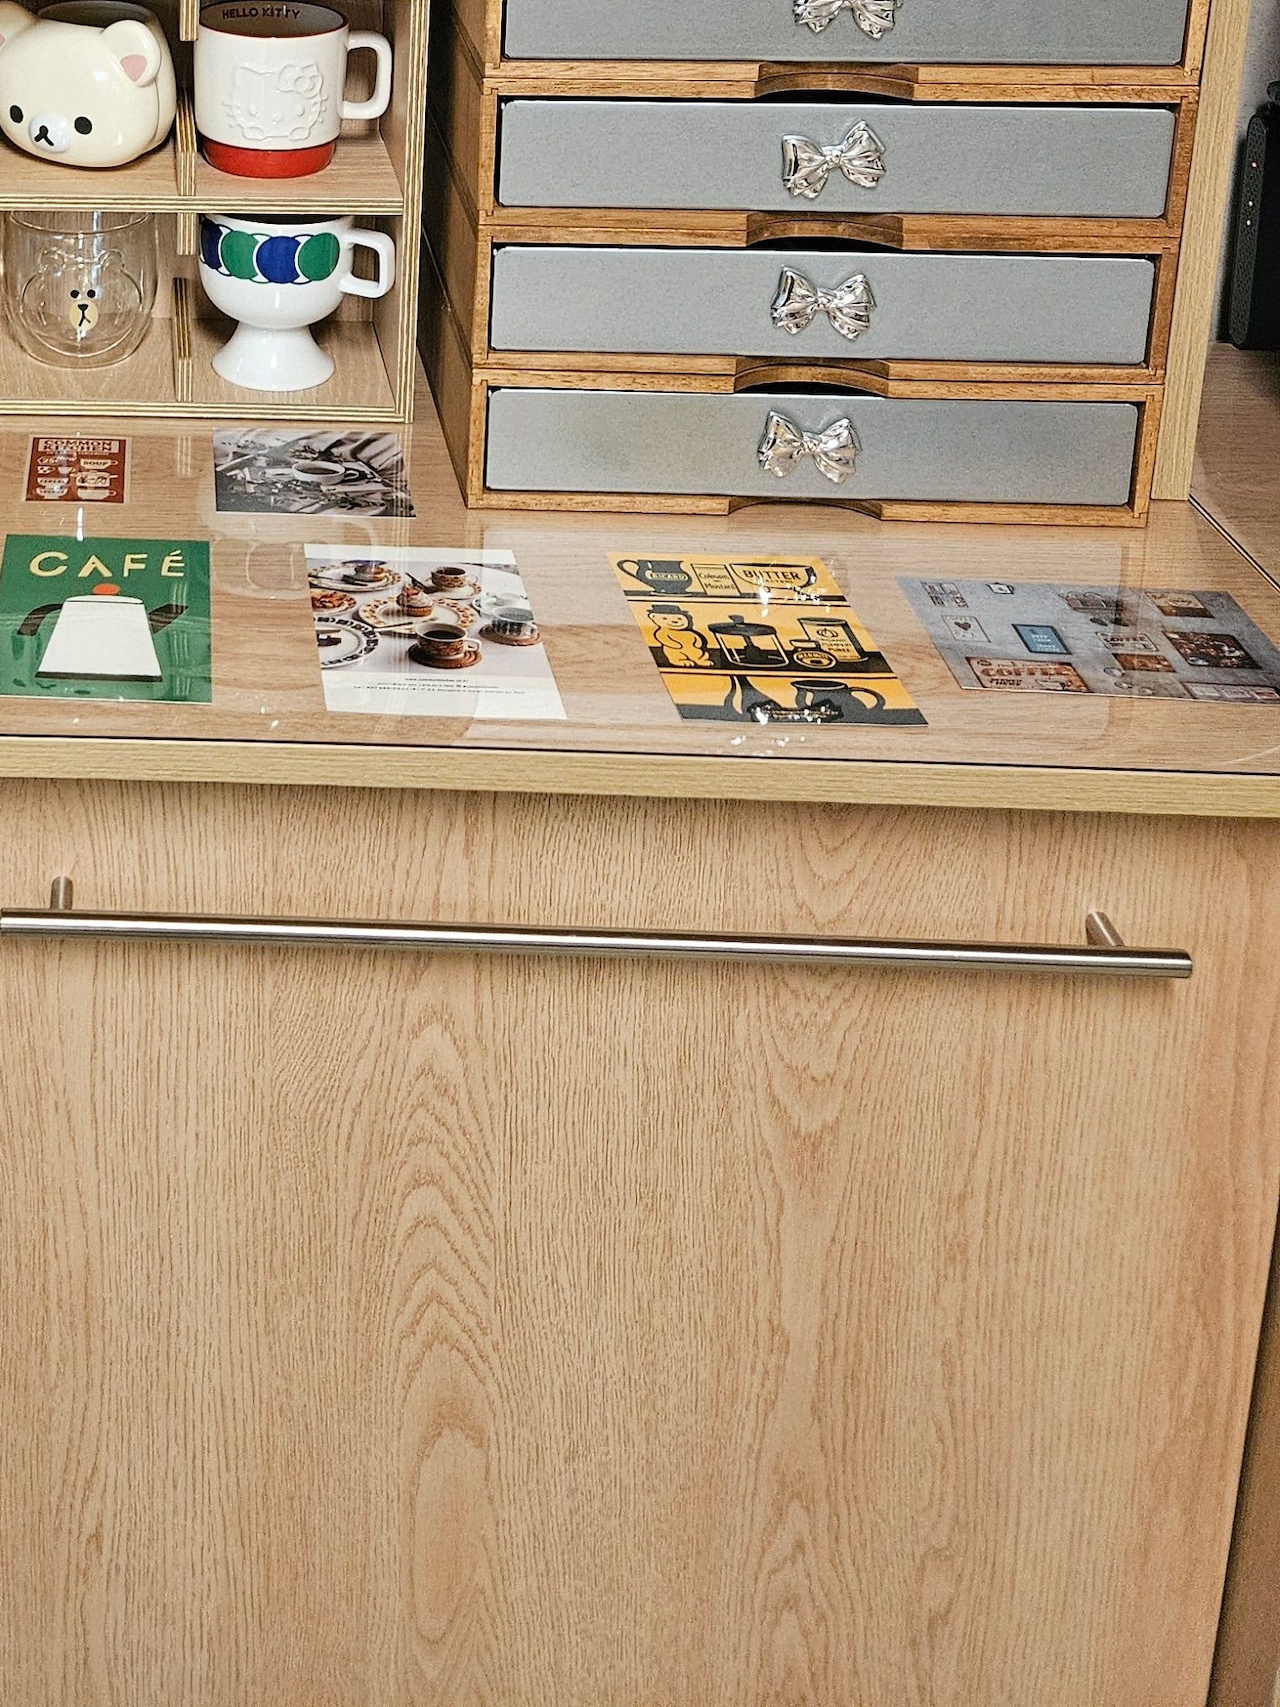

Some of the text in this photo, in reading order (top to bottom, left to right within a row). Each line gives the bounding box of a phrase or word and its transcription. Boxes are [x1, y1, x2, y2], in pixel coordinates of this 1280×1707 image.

[222, 6, 300, 20] HELLO KITTY
[44, 439, 112, 448] COMMON
[29, 549, 186, 578] CAFÉ
[743, 569, 803, 582] BUTTER
[981, 667, 1069, 678] COFFEE
